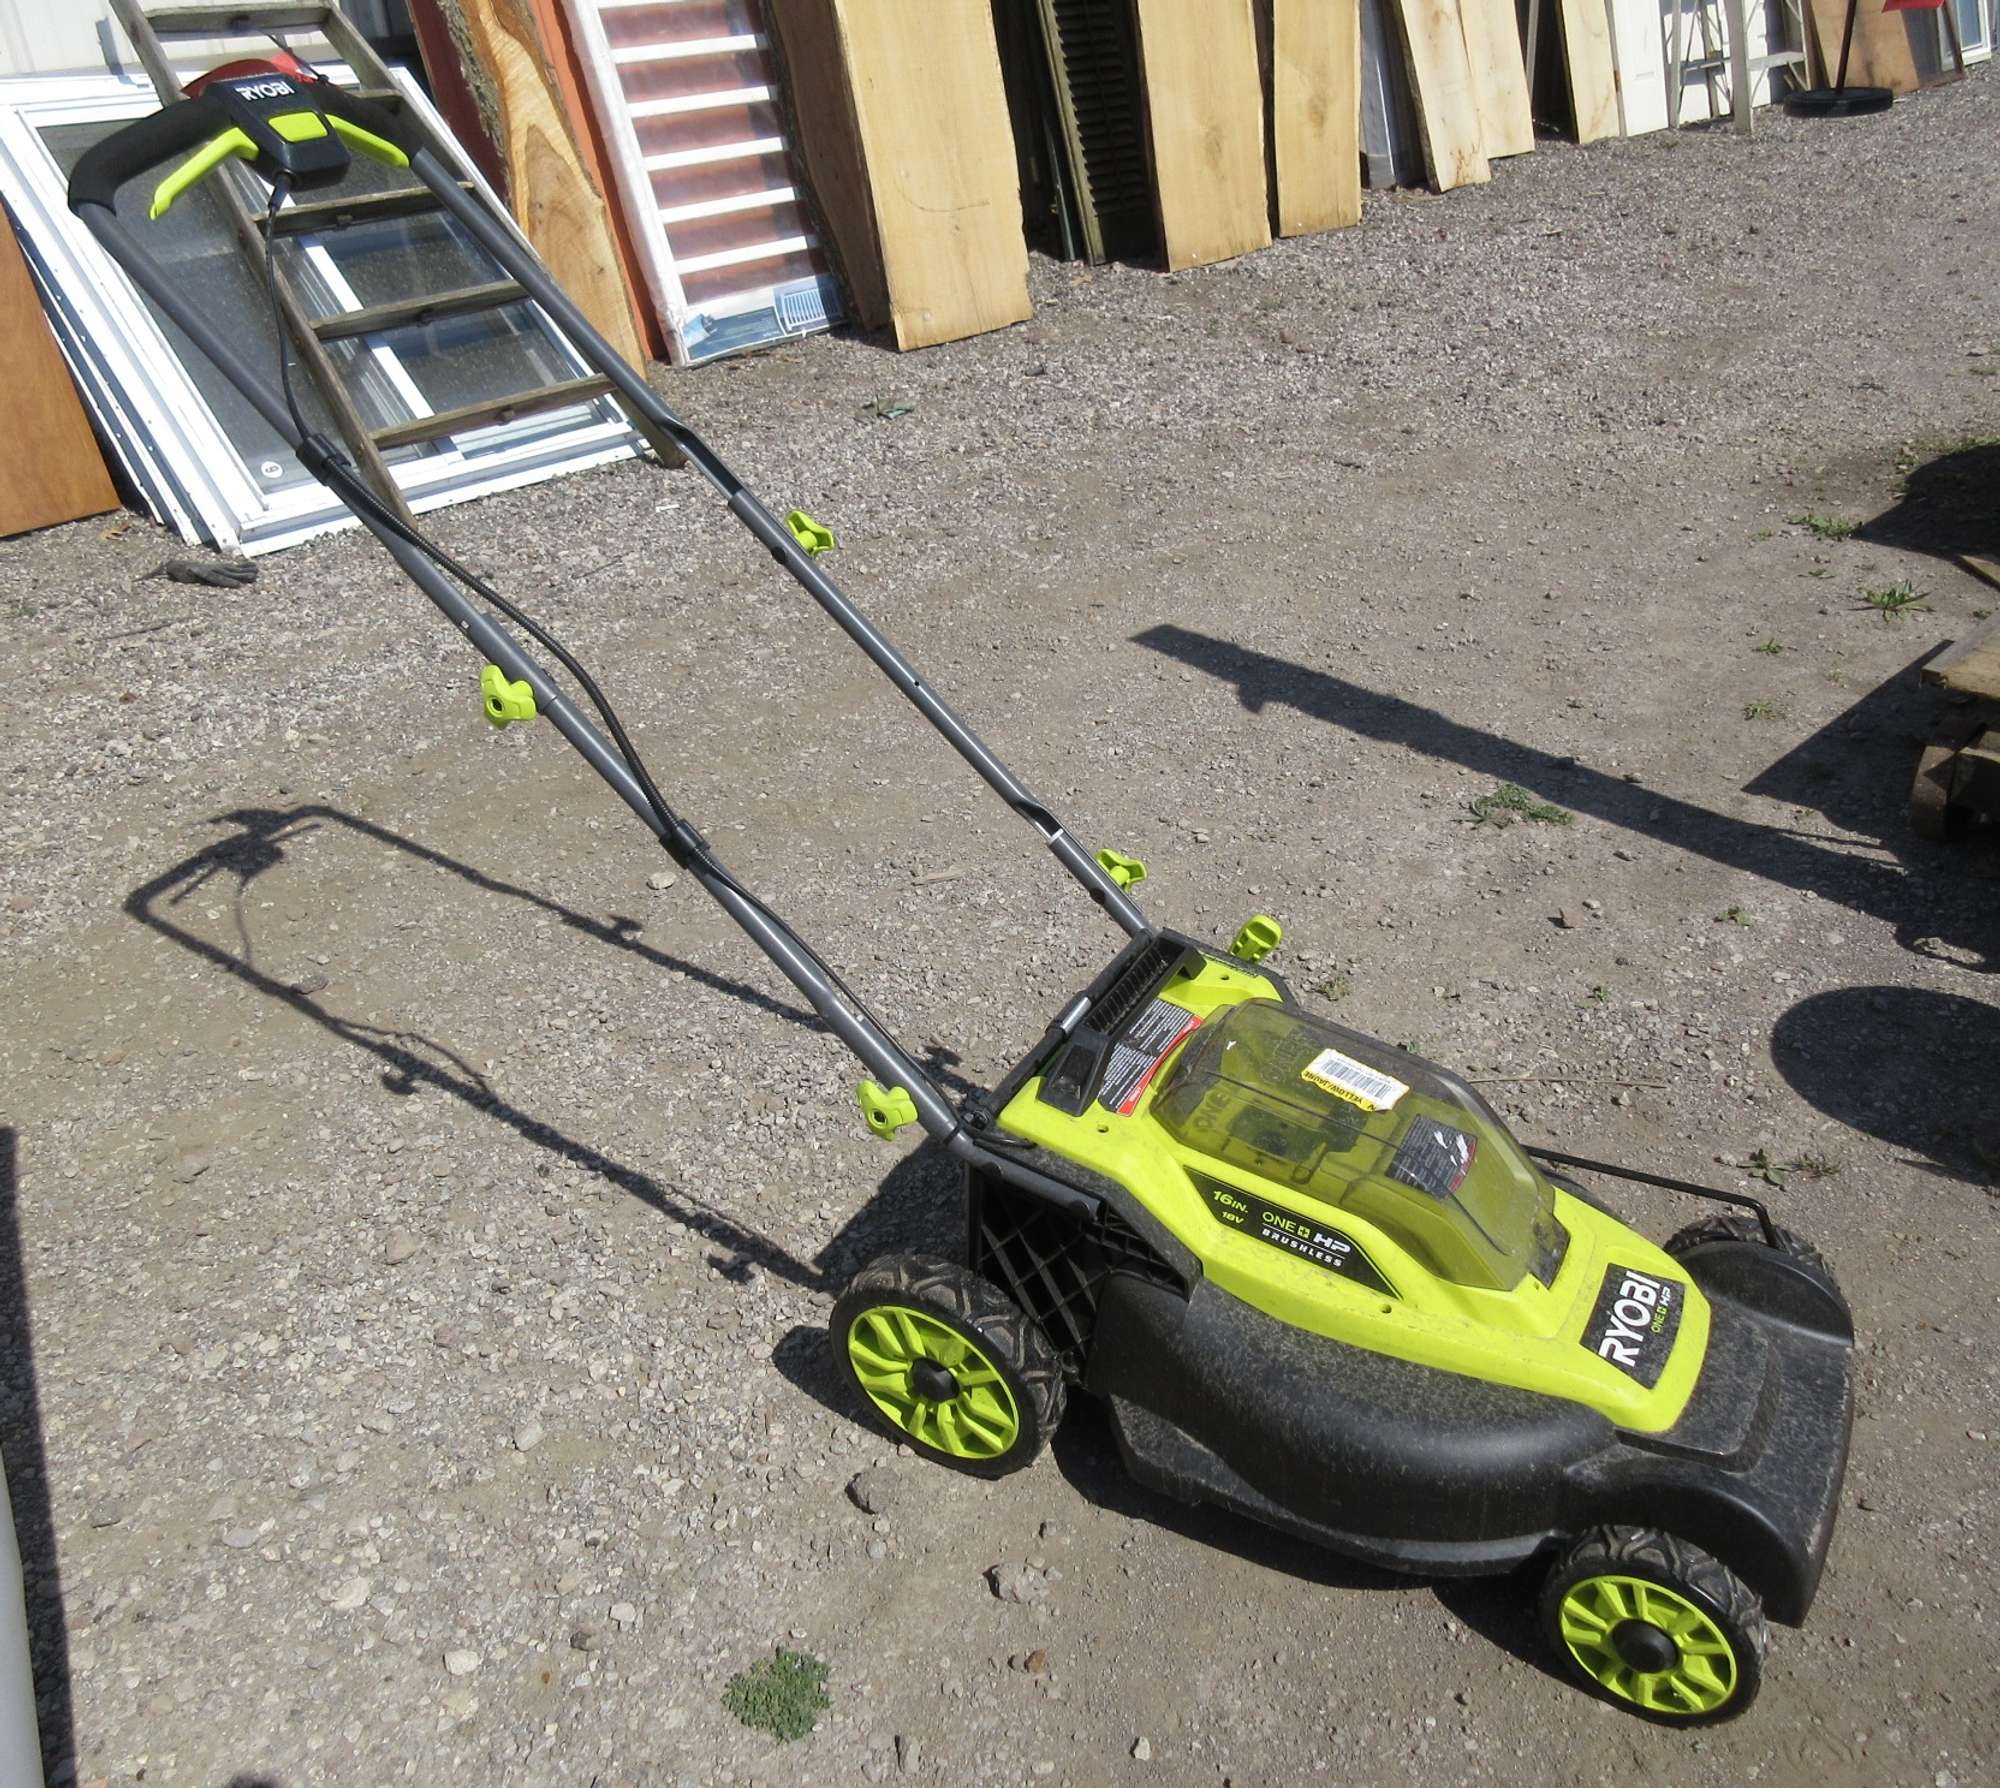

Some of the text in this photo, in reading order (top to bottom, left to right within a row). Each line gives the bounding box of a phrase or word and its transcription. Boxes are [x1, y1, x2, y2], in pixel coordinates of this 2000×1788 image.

[235, 80, 295, 101] RYOBI
[1222, 1211, 1244, 1224] 18V
[1262, 1228, 1343, 1267] BRUSHLESS
[1313, 1232, 1351, 1253] HP
[1659, 1286, 1672, 1307] HP
[1598, 1270, 1661, 1367] RYOBI
